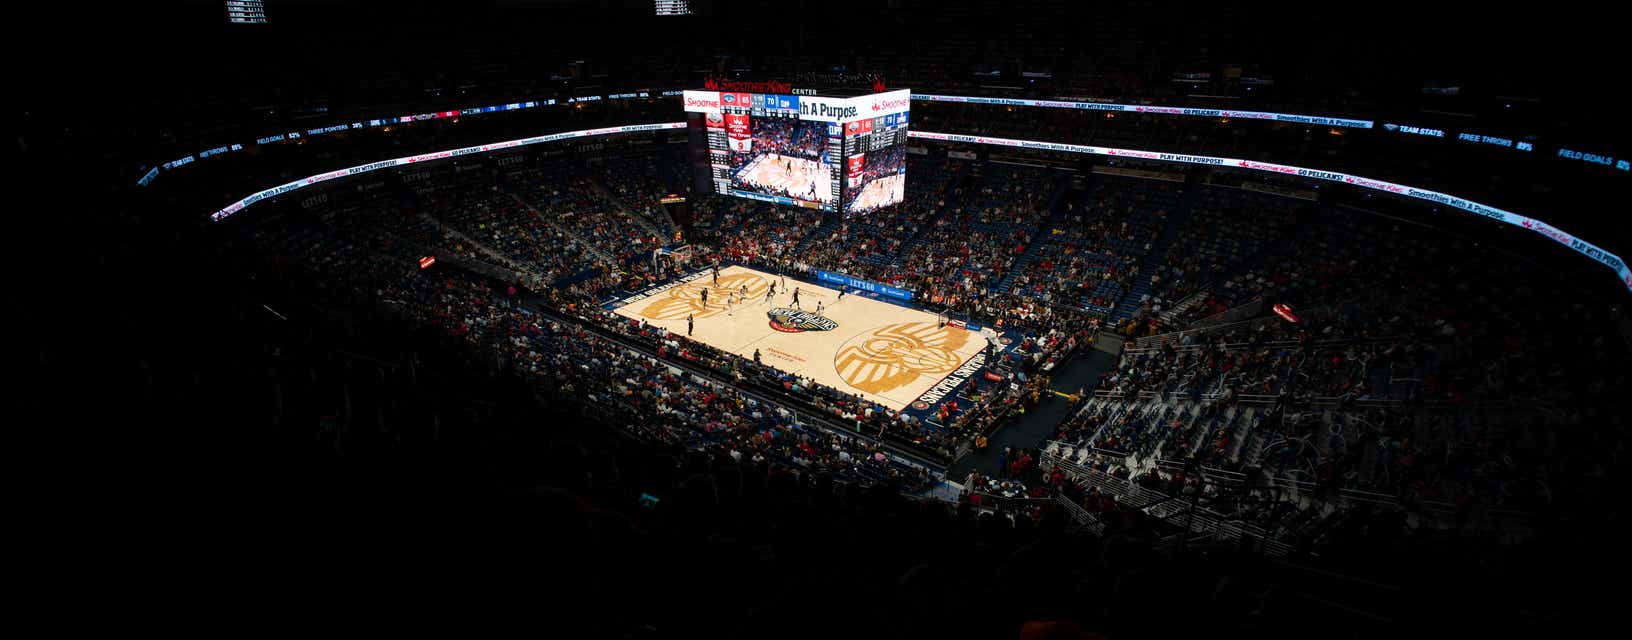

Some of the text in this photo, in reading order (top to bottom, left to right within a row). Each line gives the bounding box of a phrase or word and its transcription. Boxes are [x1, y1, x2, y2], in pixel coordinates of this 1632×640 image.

[791, 88, 817, 96] CENTER
[687, 97, 720, 108] SMOOTHIE
[811, 103, 818, 115] A
[820, 103, 858, 120] Purpose.
[1399, 125, 1445, 137] TEAM STATS:
[270, 134, 285, 143] GOALS
[1459, 132, 1513, 147] FREE THROWS
[737, 142, 744, 150] 9
[1193, 156, 1224, 165] PURPOSE!
[1558, 149, 1613, 165] FIELD GOALS
[1308, 170, 1344, 181] PELICANS!
[1408, 188, 1450, 203] Smoothies
[1450, 197, 1466, 208] With
[866, 283, 875, 291] GO
[920, 375, 965, 404] PELICANS
